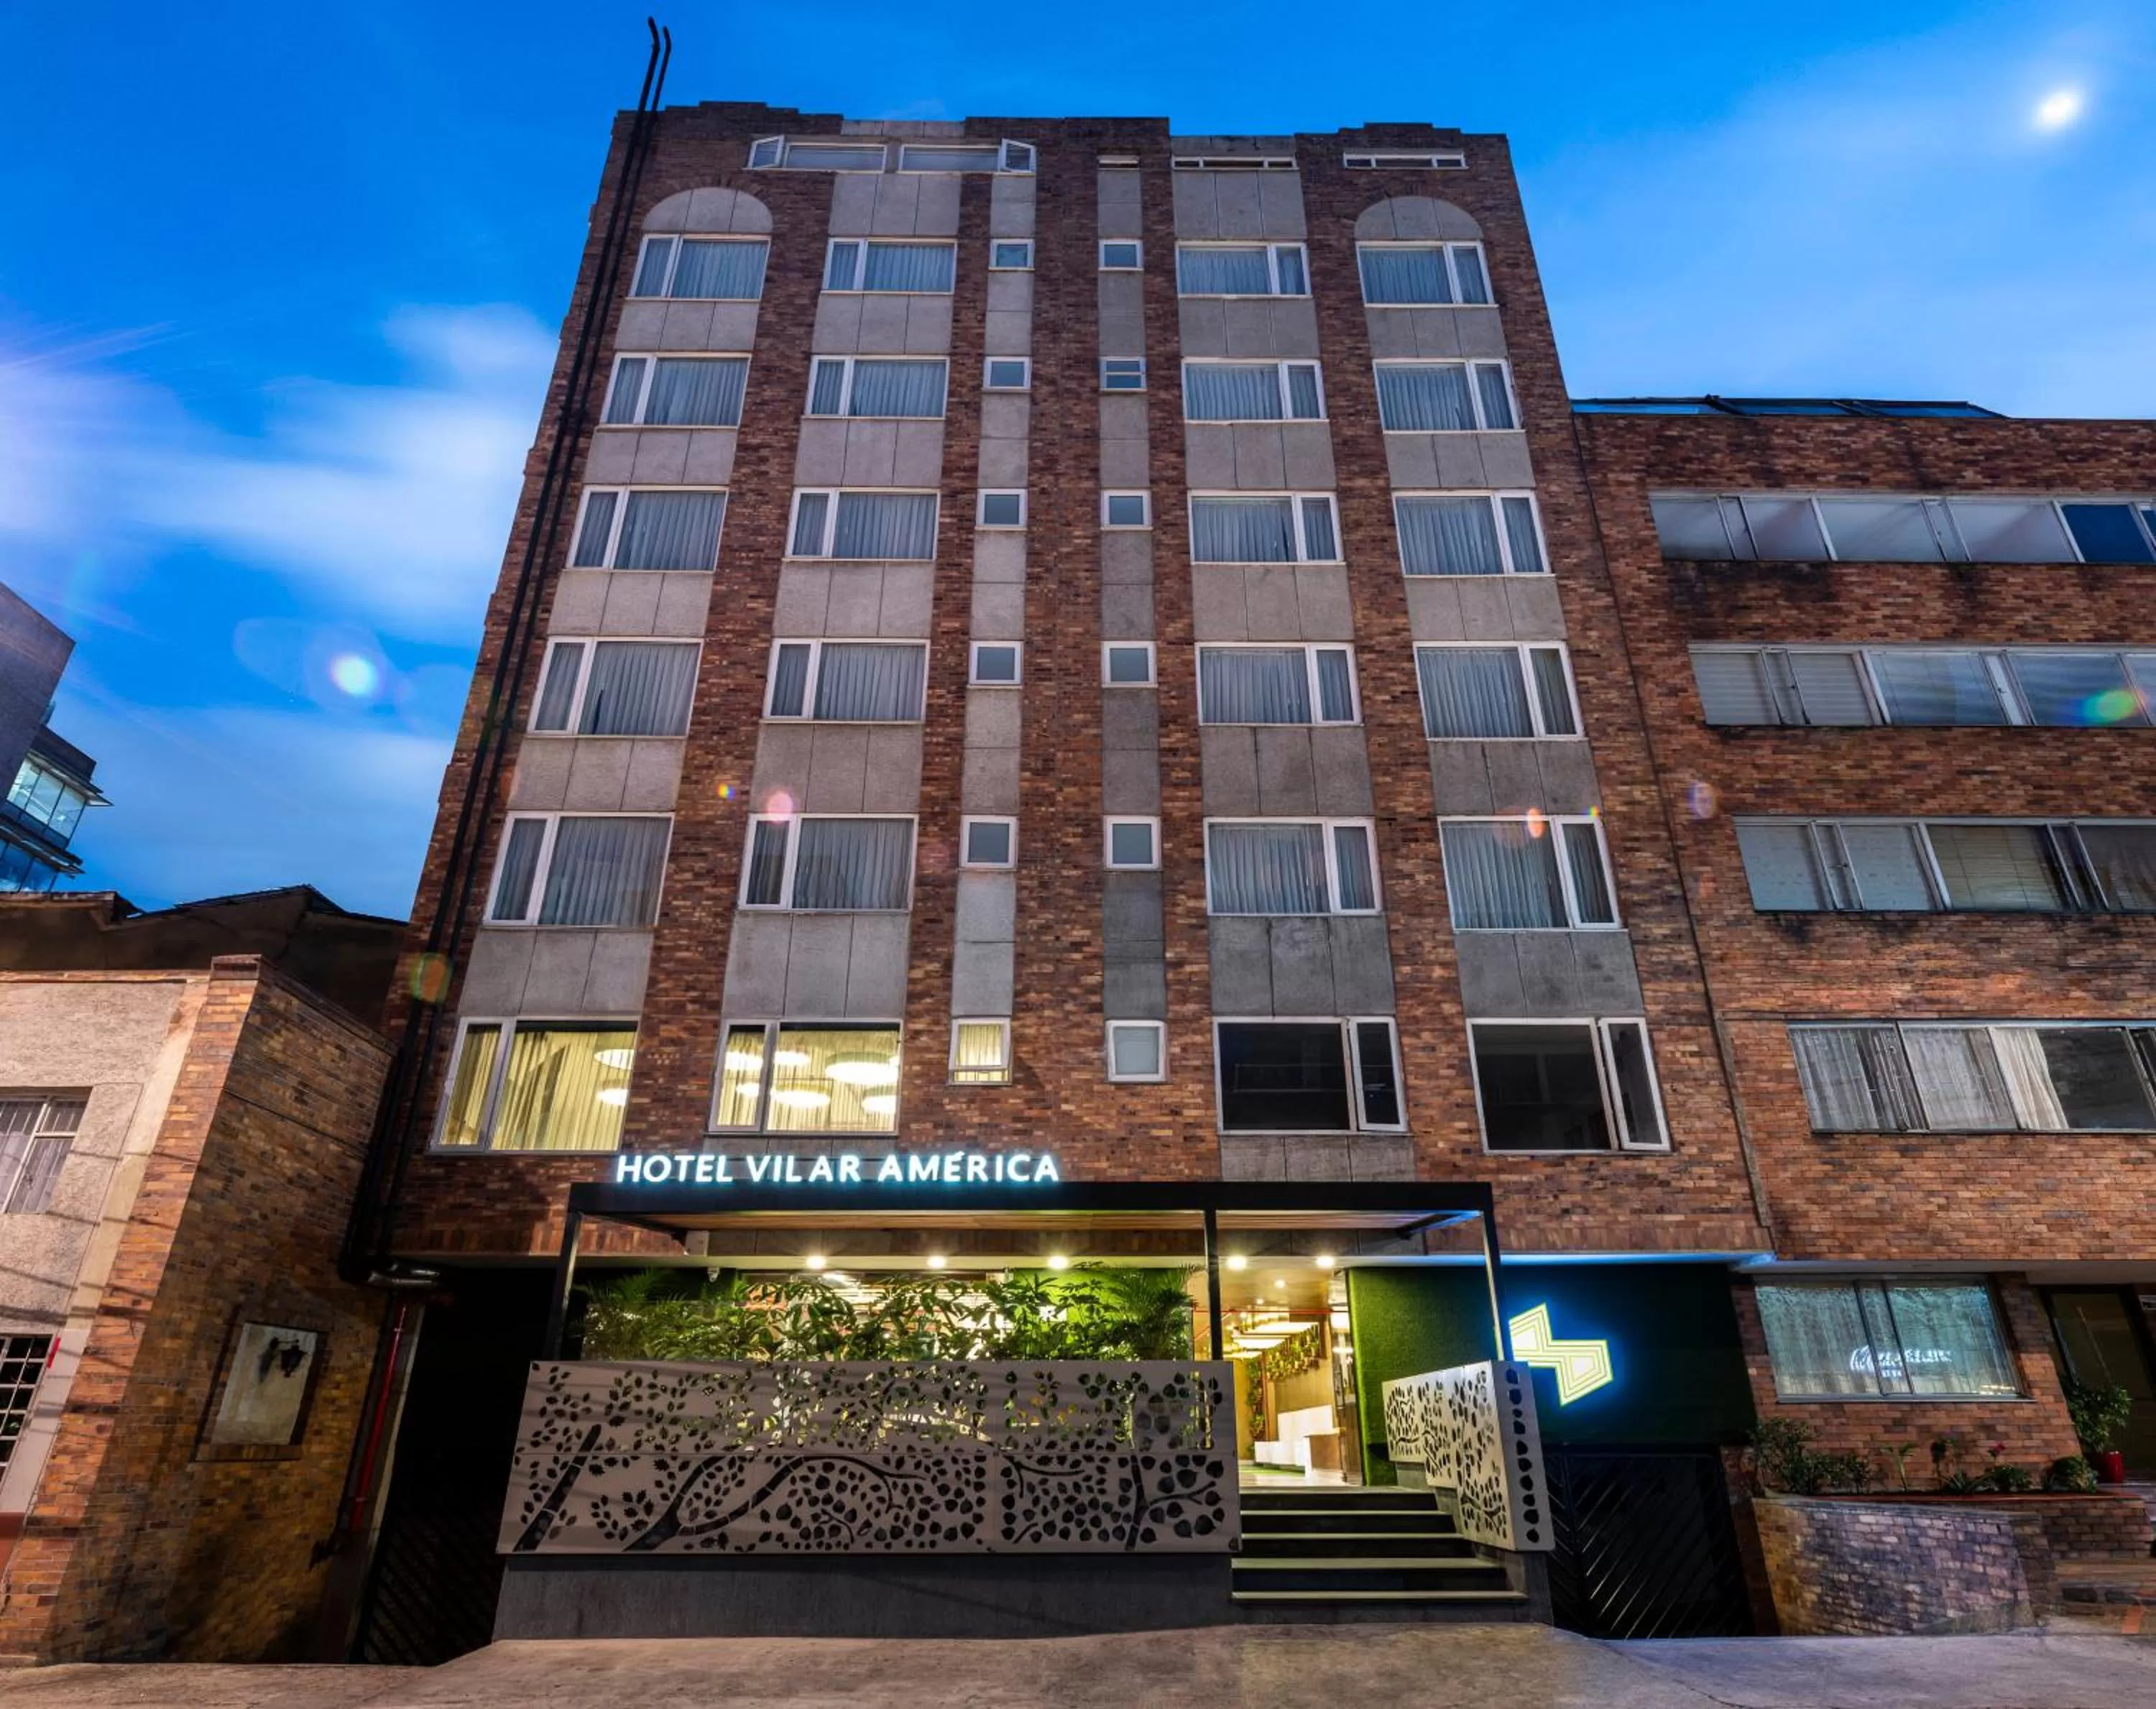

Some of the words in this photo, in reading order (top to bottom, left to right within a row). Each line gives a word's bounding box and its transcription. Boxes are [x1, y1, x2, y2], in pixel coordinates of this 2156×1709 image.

[616, 1154, 732, 1181] HOTEL
[746, 1154, 861, 1181] VILAR
[877, 1151, 1059, 1181] AMÉRICA
